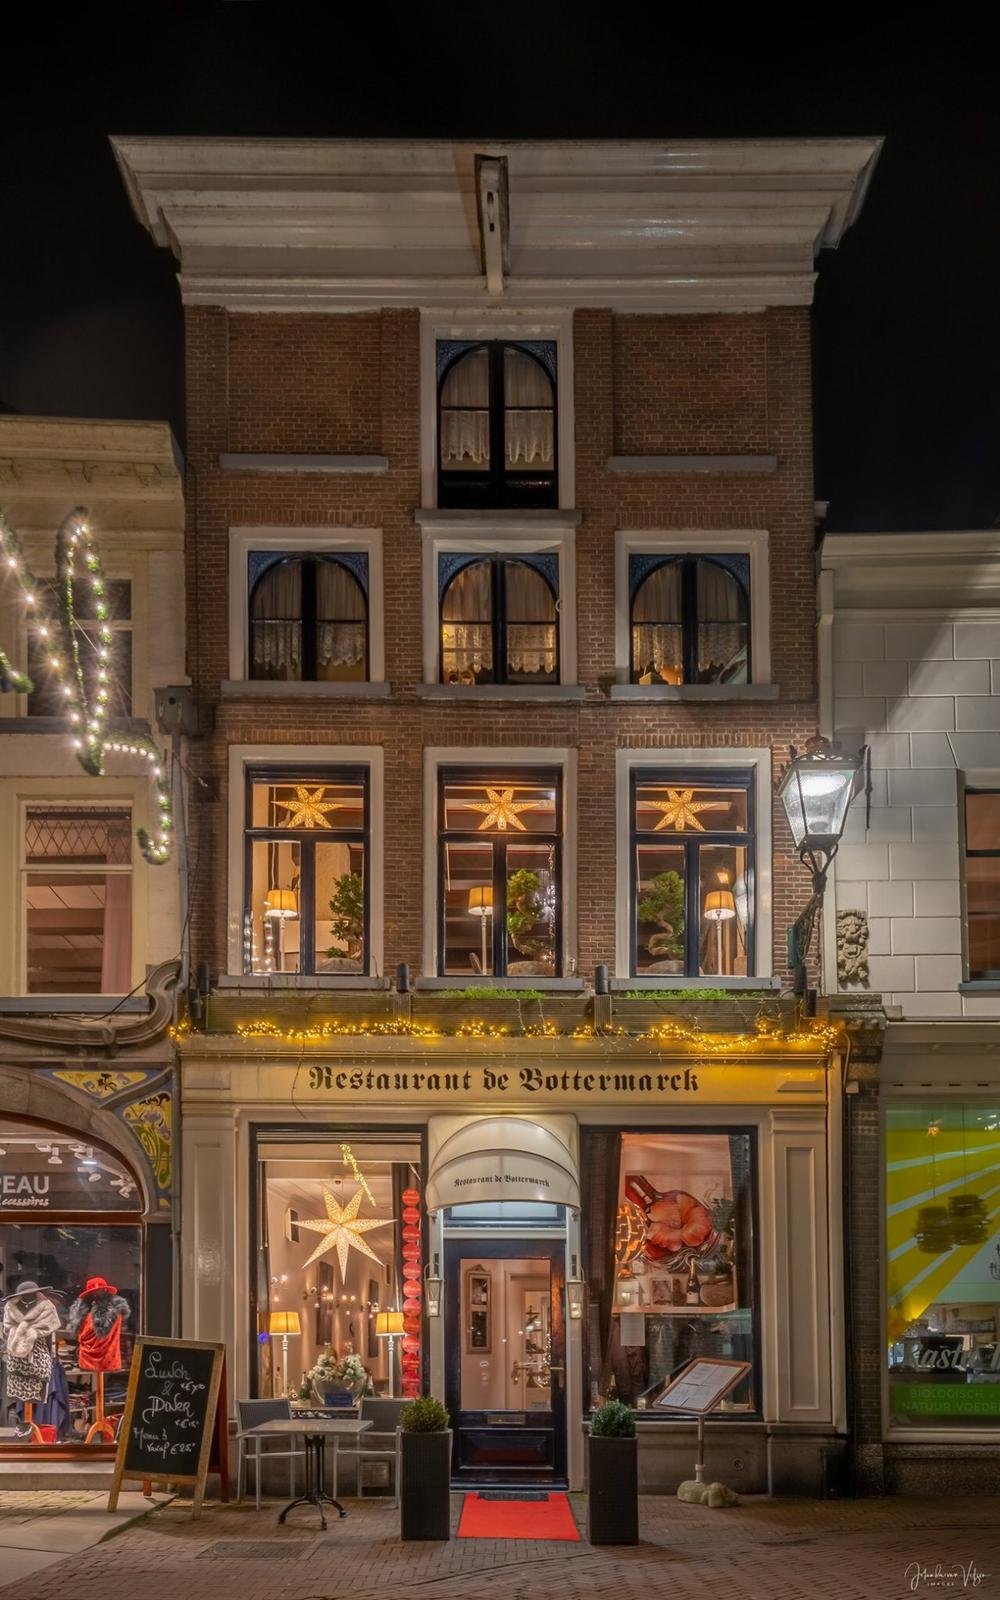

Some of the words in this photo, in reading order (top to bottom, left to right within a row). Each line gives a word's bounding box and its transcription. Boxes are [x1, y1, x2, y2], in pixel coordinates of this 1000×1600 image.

[308, 1065, 472, 1091] Restaurant
[483, 1066, 509, 1091] de
[519, 1067, 699, 1092] Bottermarck
[0, 1175, 50, 1194] EAU
[454, 1175, 493, 1187] Restaurant
[494, 1174, 503, 1183] de
[503, 1174, 550, 1187] Bottermarck
[0, 1195, 49, 1207] ccessoires
